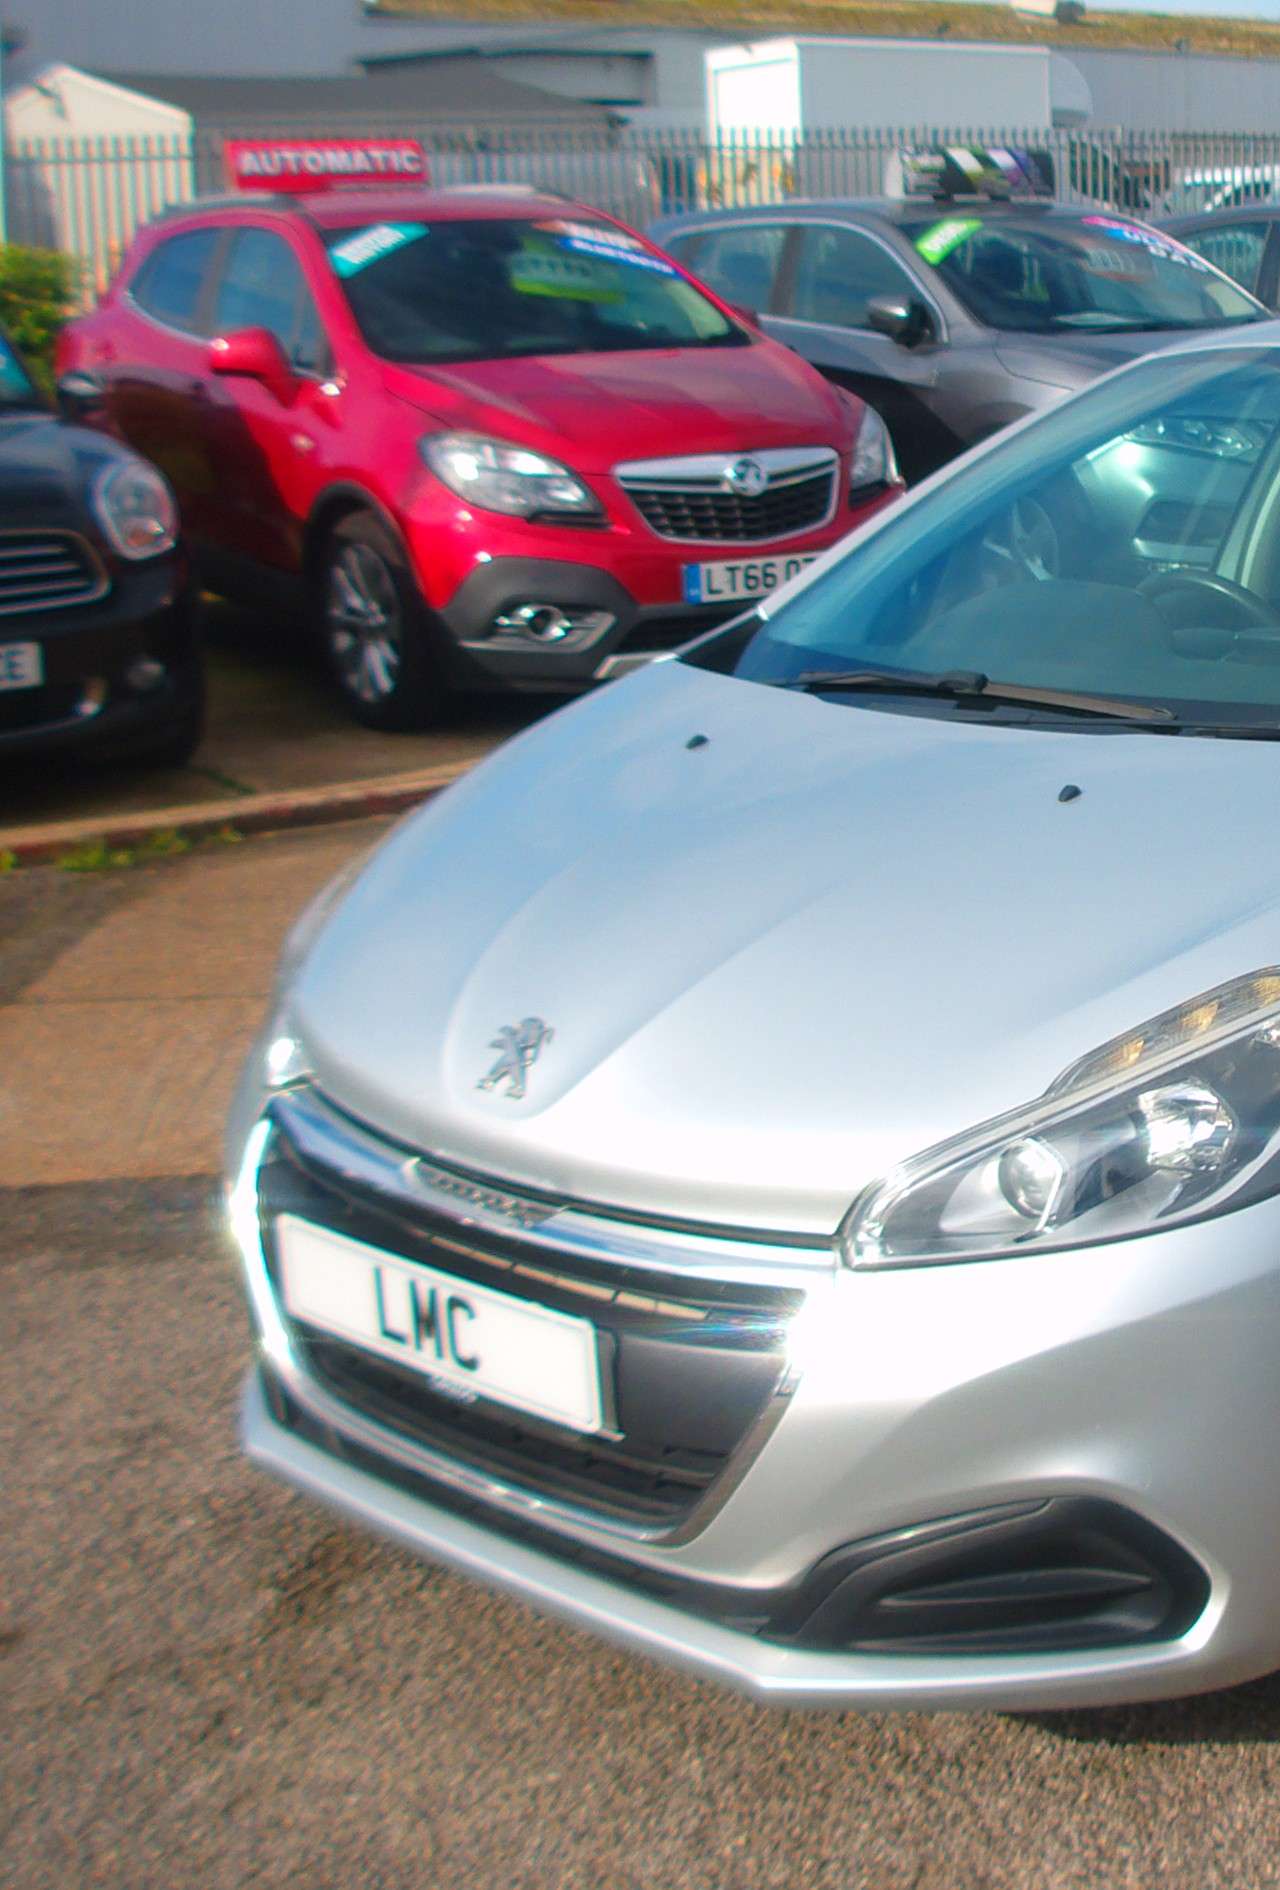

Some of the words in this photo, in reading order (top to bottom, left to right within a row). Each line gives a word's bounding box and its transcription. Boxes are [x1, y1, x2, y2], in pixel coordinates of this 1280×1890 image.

[238, 148, 422, 175] AUTOMATIC
[705, 563, 778, 594] LT66
[373, 1266, 480, 1372] LMC
